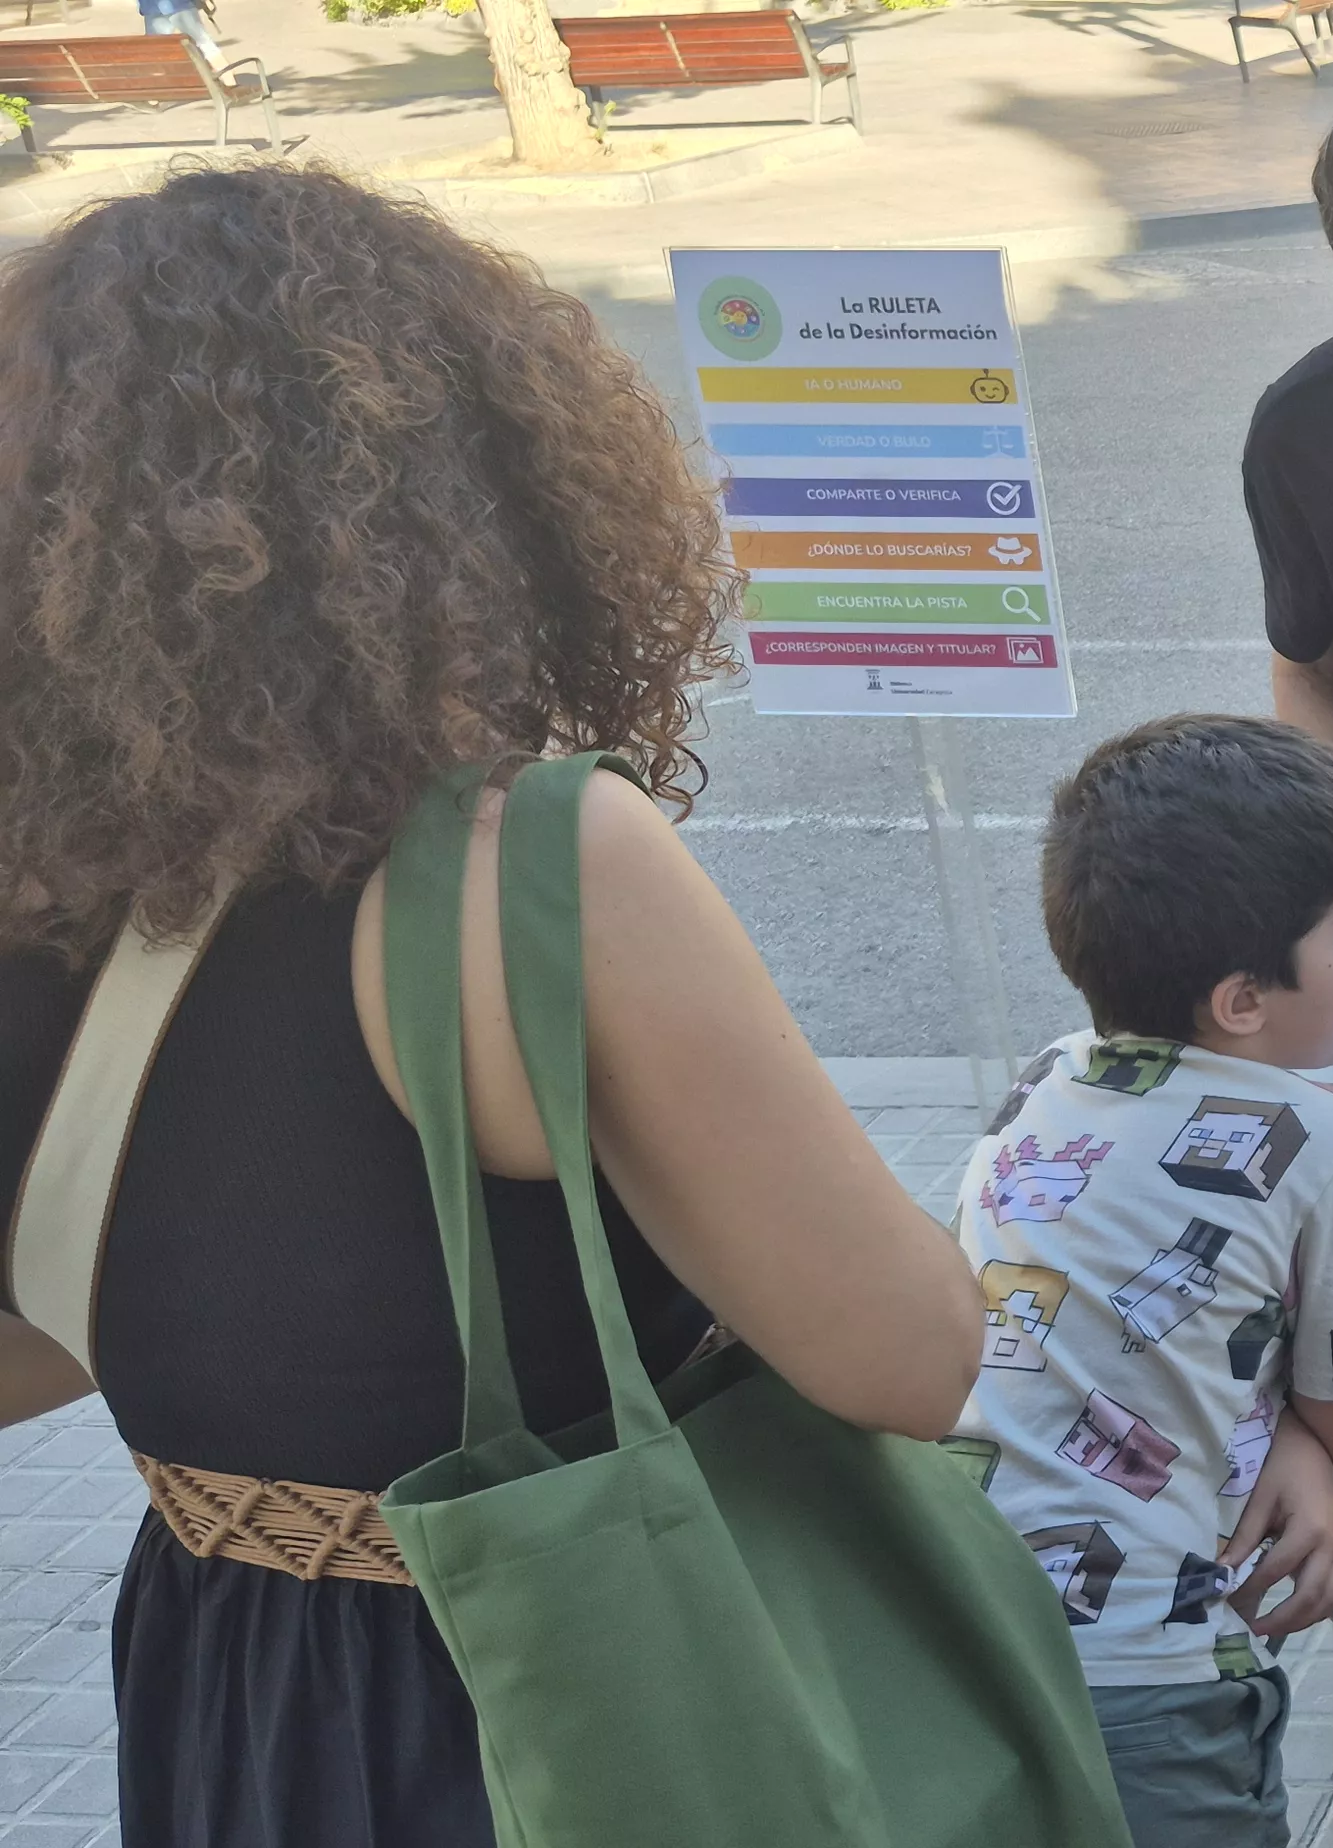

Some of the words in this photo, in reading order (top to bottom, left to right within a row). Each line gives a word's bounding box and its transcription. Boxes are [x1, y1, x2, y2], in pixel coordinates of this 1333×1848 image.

[840, 296, 864, 314] La
[868, 297, 942, 314] RULETA
[799, 322, 823, 340] de
[827, 322, 845, 340] la
[849, 322, 998, 341] Desinformación
[838, 379, 903, 391] HUMANO
[817, 435, 876, 448] VERDAD
[893, 436, 931, 448] BULO
[806, 488, 882, 501] COMPARTE
[886, 489, 896, 501] O
[899, 489, 962, 501] VERIFICA
[807, 541, 862, 557] ¿DÓNDE
[866, 544, 884, 556] LO
[887, 542, 972, 557] BUSCARÍAS?
[817, 595, 903, 609] ENCUENTRA
[905, 596, 924, 609] LA
[927, 596, 968, 609] PISTA
[765, 641, 874, 655] ¿CORRESPONDEN
[875, 643, 926, 655] IMAGEN
[927, 644, 935, 654] Y
[937, 644, 996, 655] TITULAR?
